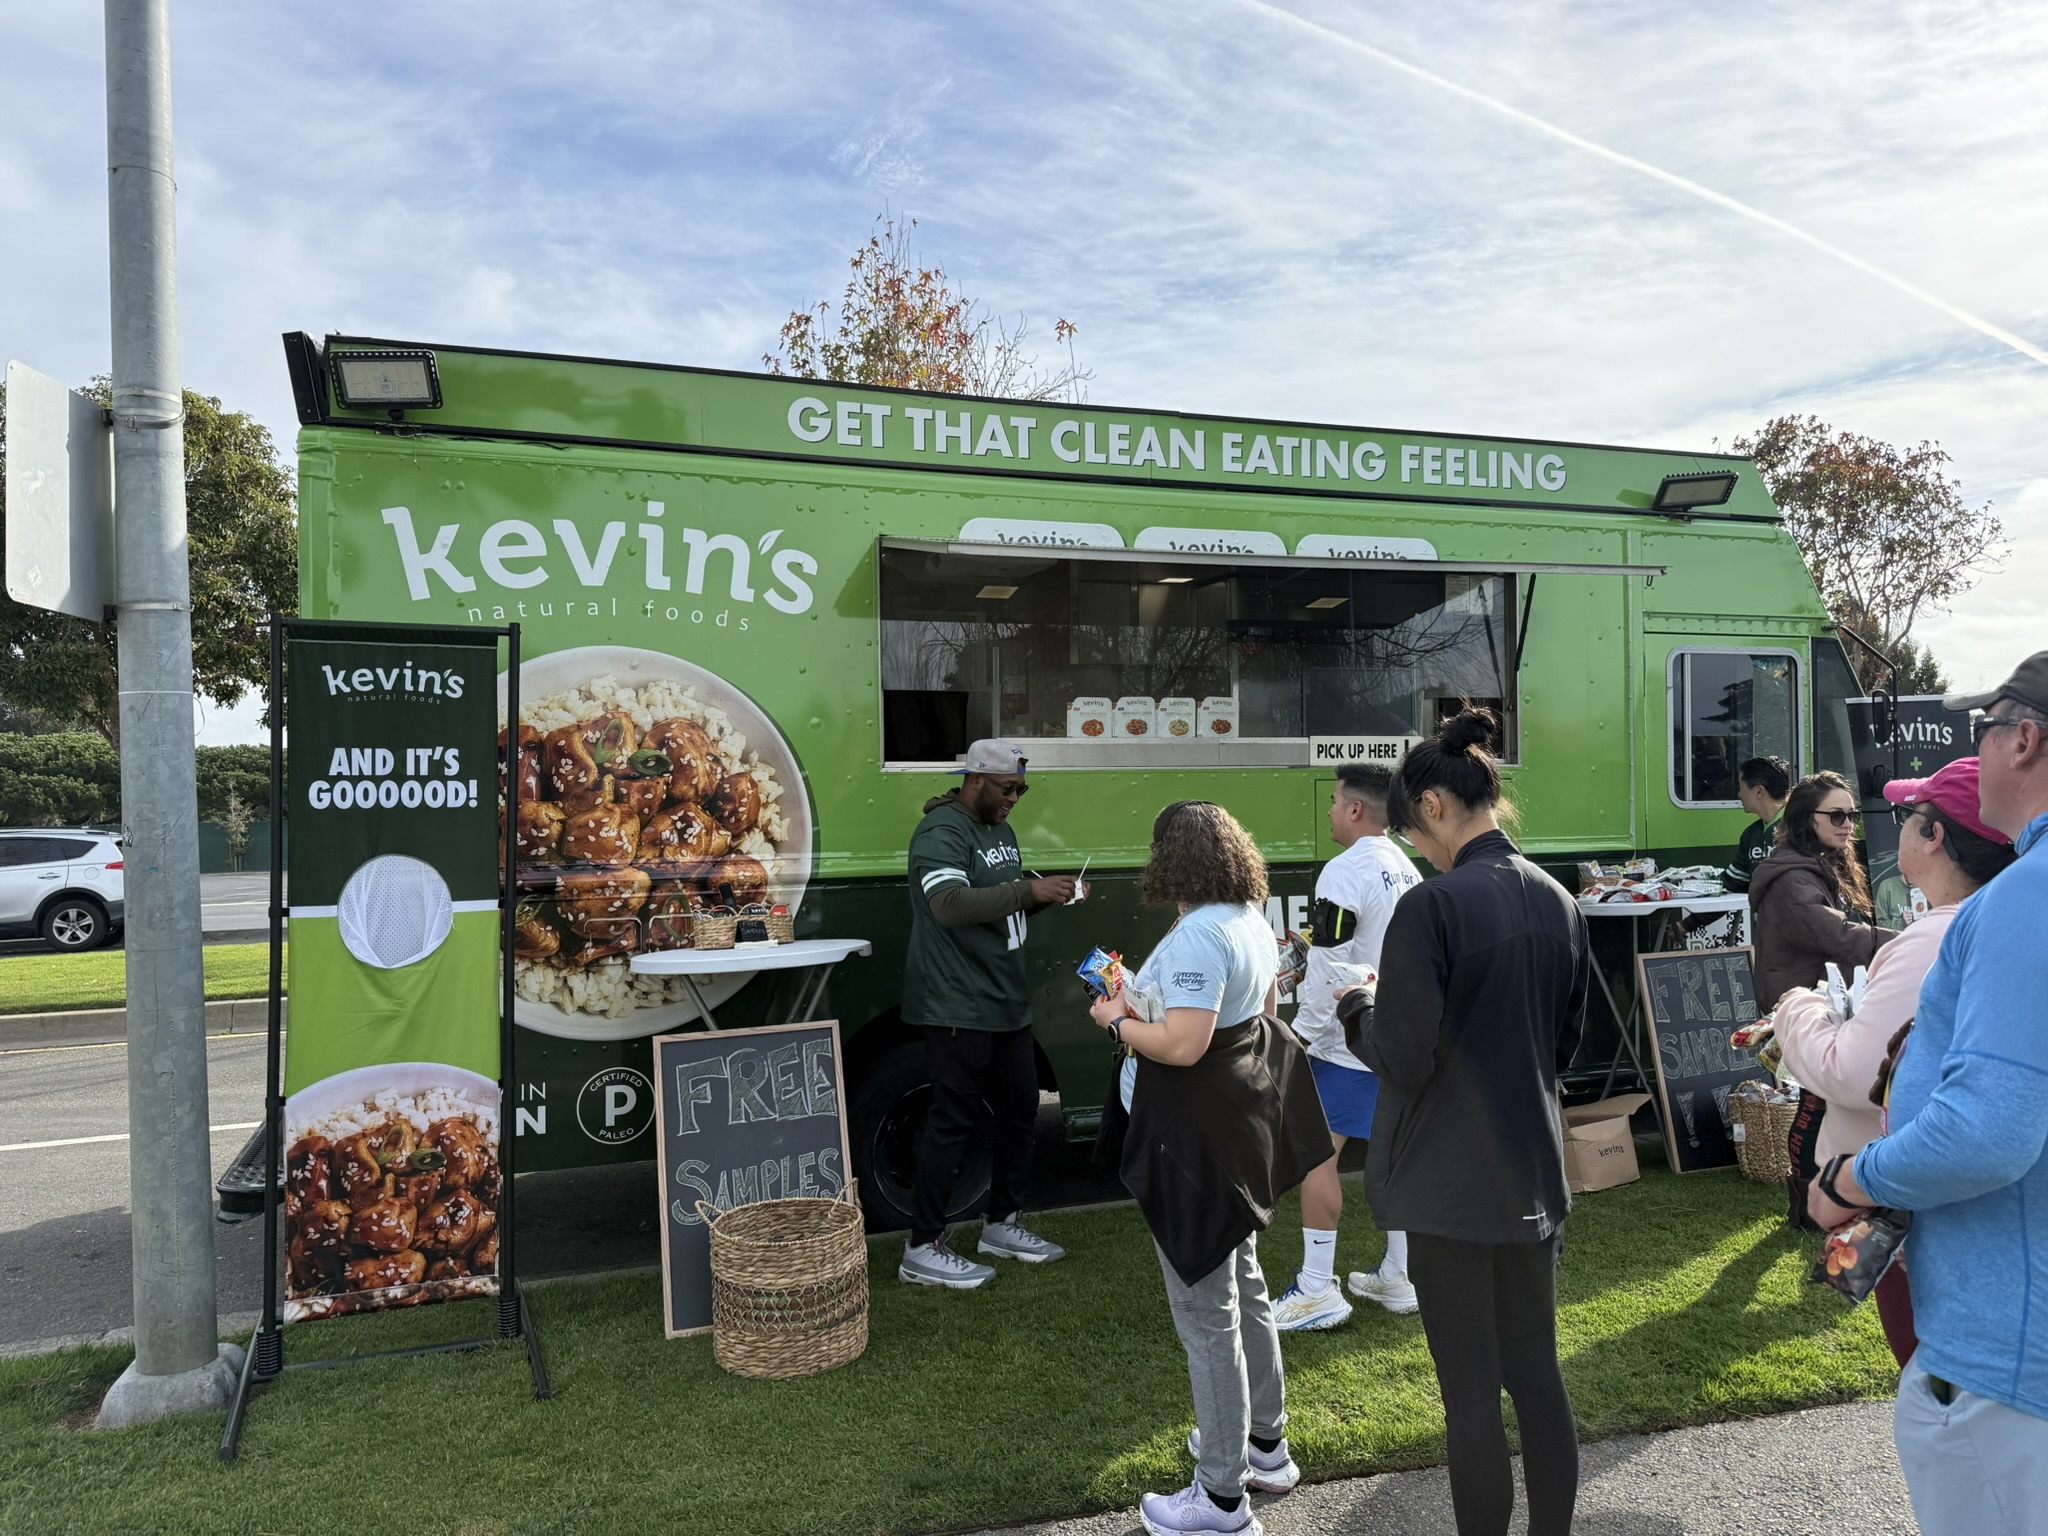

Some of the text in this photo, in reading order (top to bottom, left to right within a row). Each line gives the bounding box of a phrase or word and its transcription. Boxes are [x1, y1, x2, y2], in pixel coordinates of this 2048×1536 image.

[787, 397, 1568, 491] GET THAT CLEAN EATING FEELING
[381, 500, 818, 614] kevin's
[468, 598, 750, 631] natural foods
[321, 661, 465, 698] kevin's
[347, 693, 441, 705] natural foods
[328, 746, 460, 776] AND IT'S
[1317, 743, 1397, 759] PICK UP HERE
[308, 779, 478, 810] GOOOOOD!
[1647, 955, 1758, 1022] FREE
[521, 1082, 546, 1101] IN
[590, 1072, 643, 1092] CERTIFIED
[676, 1037, 838, 1136] FREE
[605, 1085, 637, 1127] P
[599, 1127, 635, 1140] PALEO
[1598, 1144, 1625, 1158] kevin's
[671, 1148, 840, 1226] SAMPLES
